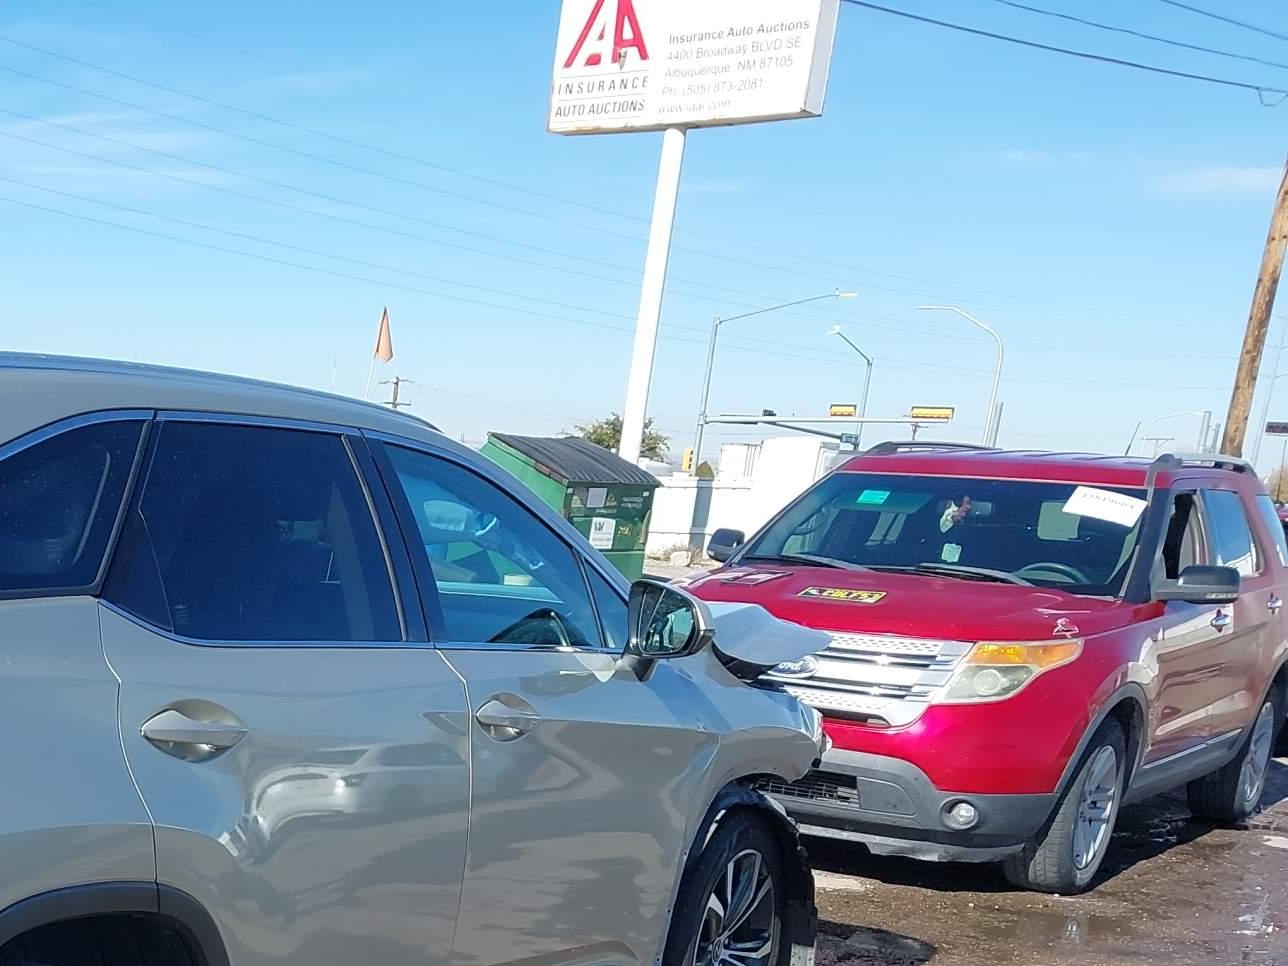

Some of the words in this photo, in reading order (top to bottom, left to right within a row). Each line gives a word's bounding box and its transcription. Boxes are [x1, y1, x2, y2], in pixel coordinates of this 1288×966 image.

[668, 31, 724, 45] Insurance
[726, 25, 754, 39] Auto
[756, 19, 811, 34] Auctions
[665, 48, 693, 61] 4400
[695, 43, 748, 59] Broadway
[750, 38, 783, 53] BLVD
[785, 36, 803, 49] SE
[736, 59, 757, 73] NM
[758, 56, 794, 70] 87105
[557, 75, 649, 96] INSURANCE
[554, 104, 586, 118] AUTO
[587, 99, 645, 116] AUCTIONS
